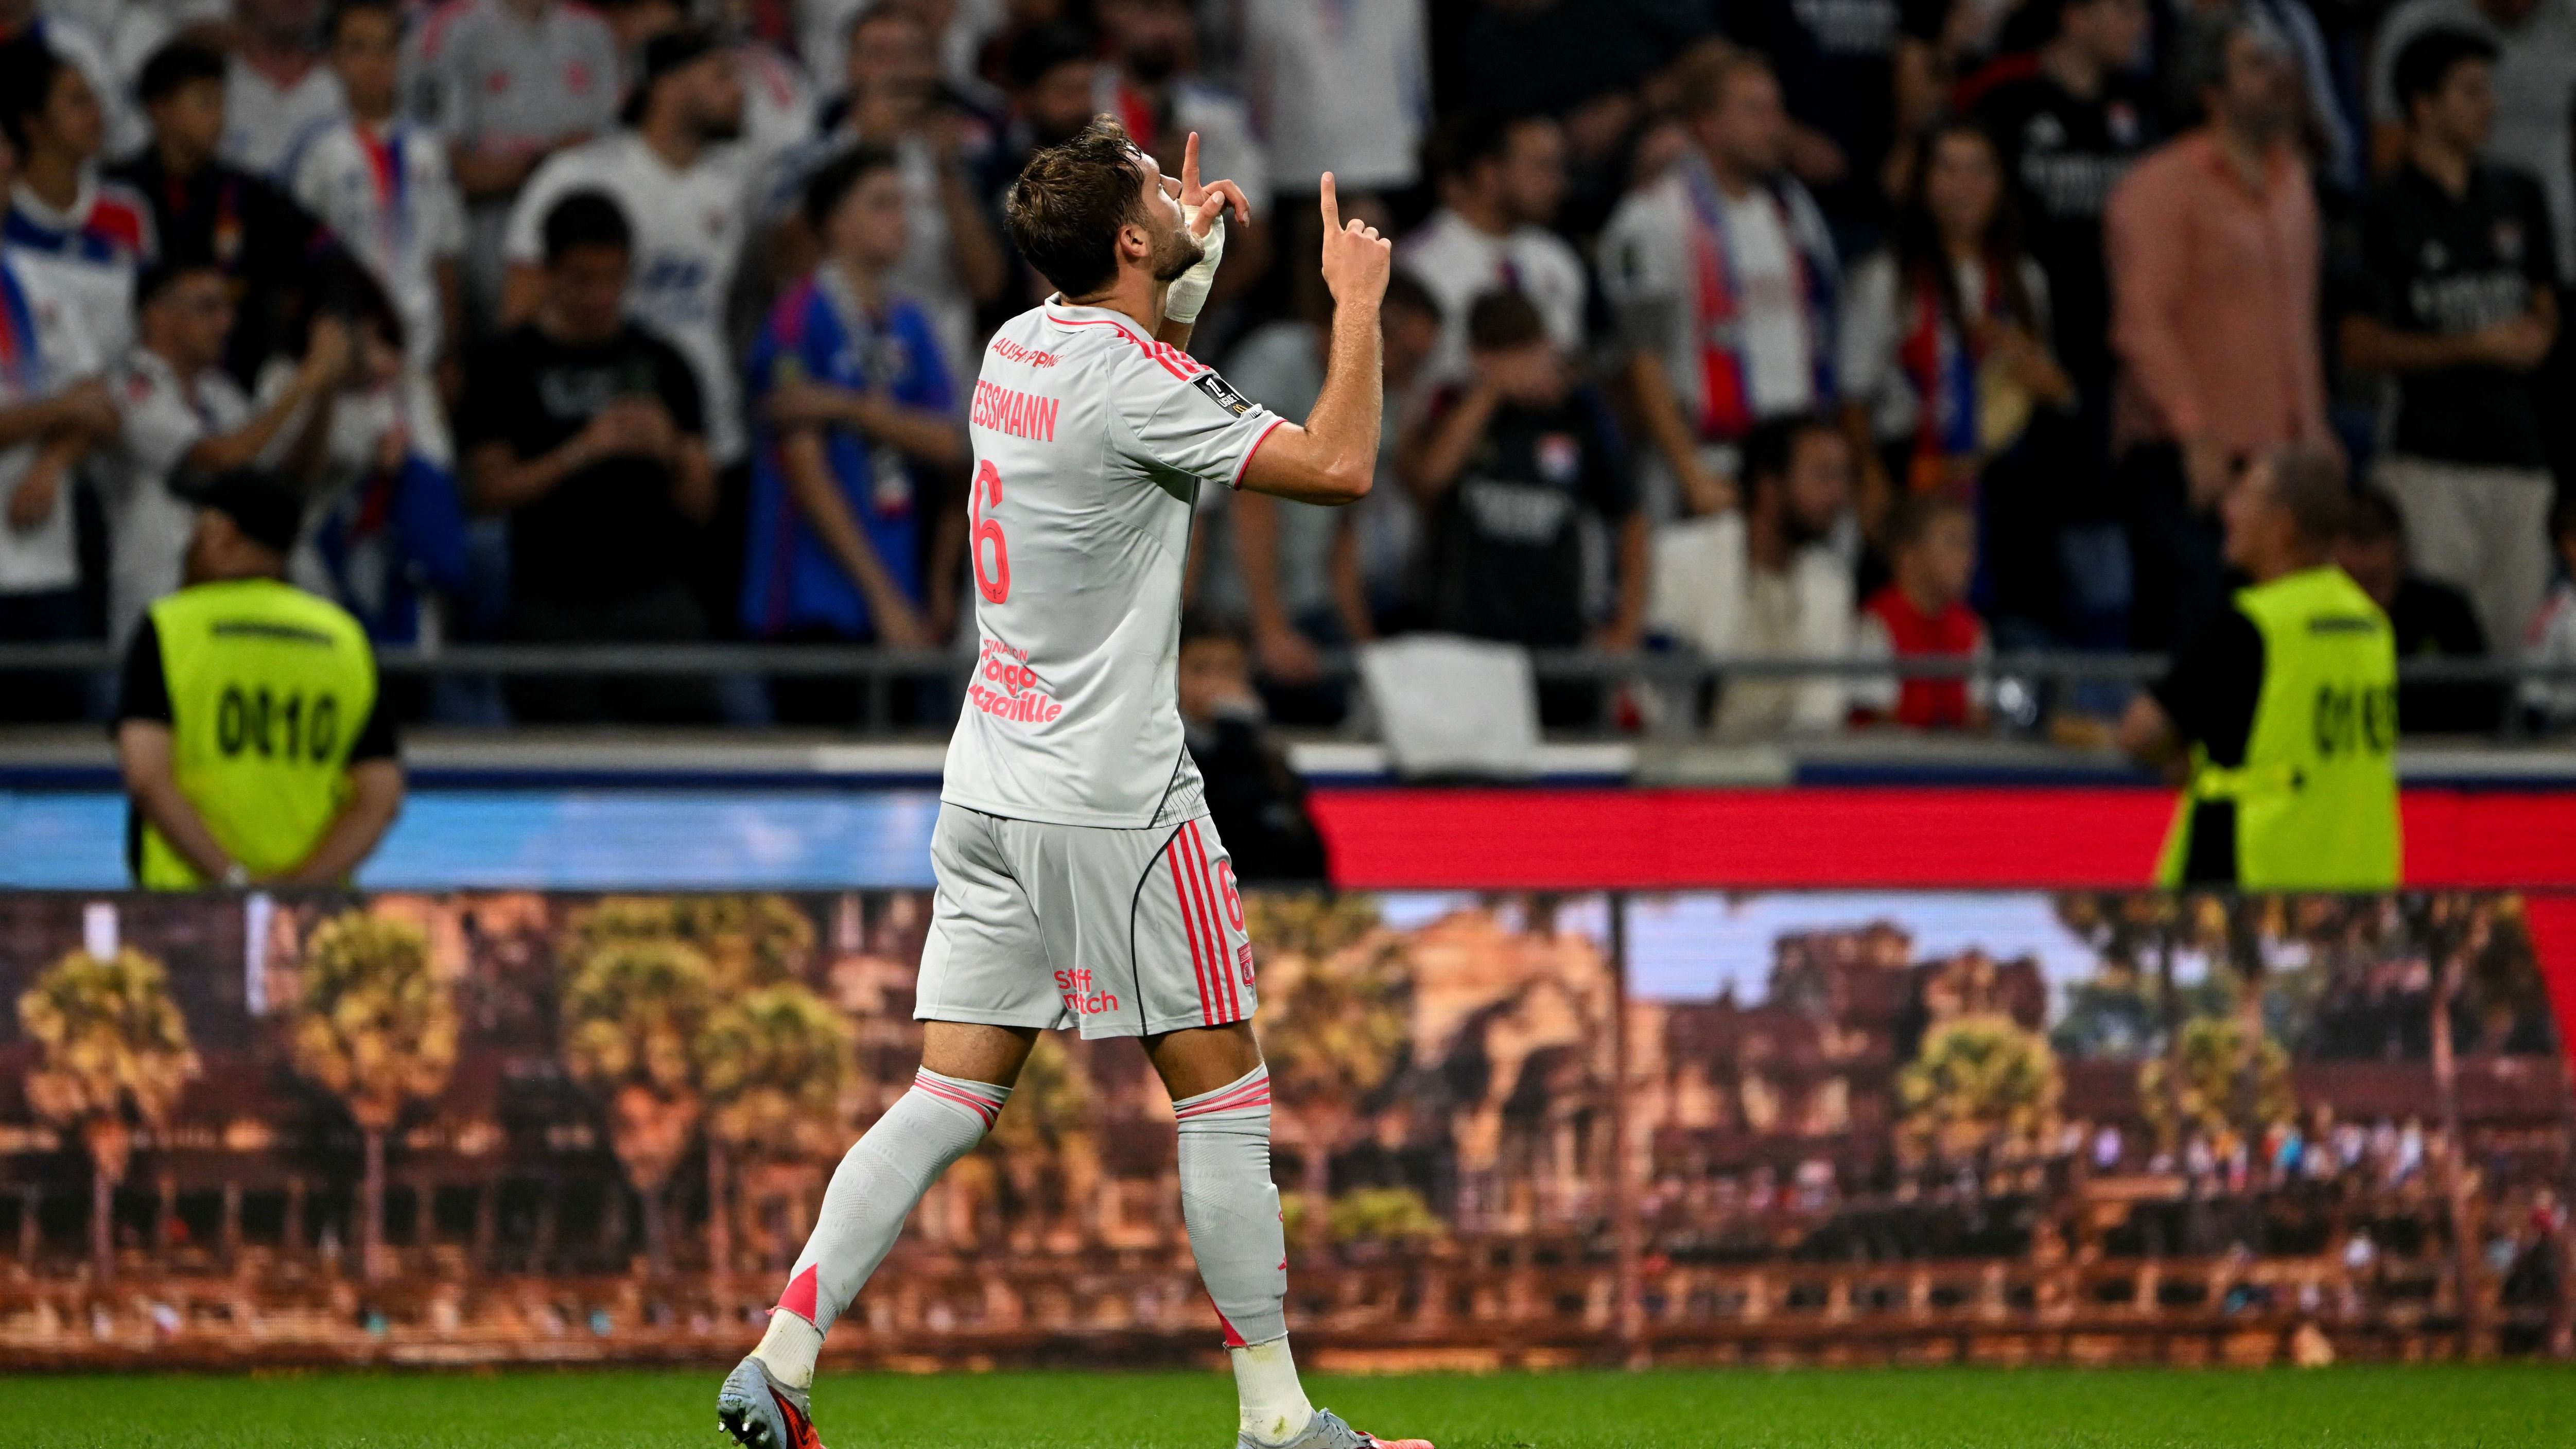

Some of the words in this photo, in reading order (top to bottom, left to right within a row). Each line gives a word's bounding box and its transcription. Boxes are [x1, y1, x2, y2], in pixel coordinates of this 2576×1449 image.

[970, 379, 1059, 442] ESSMANN
[972, 459, 1010, 604] 6
[1219, 860, 1244, 932] 6
